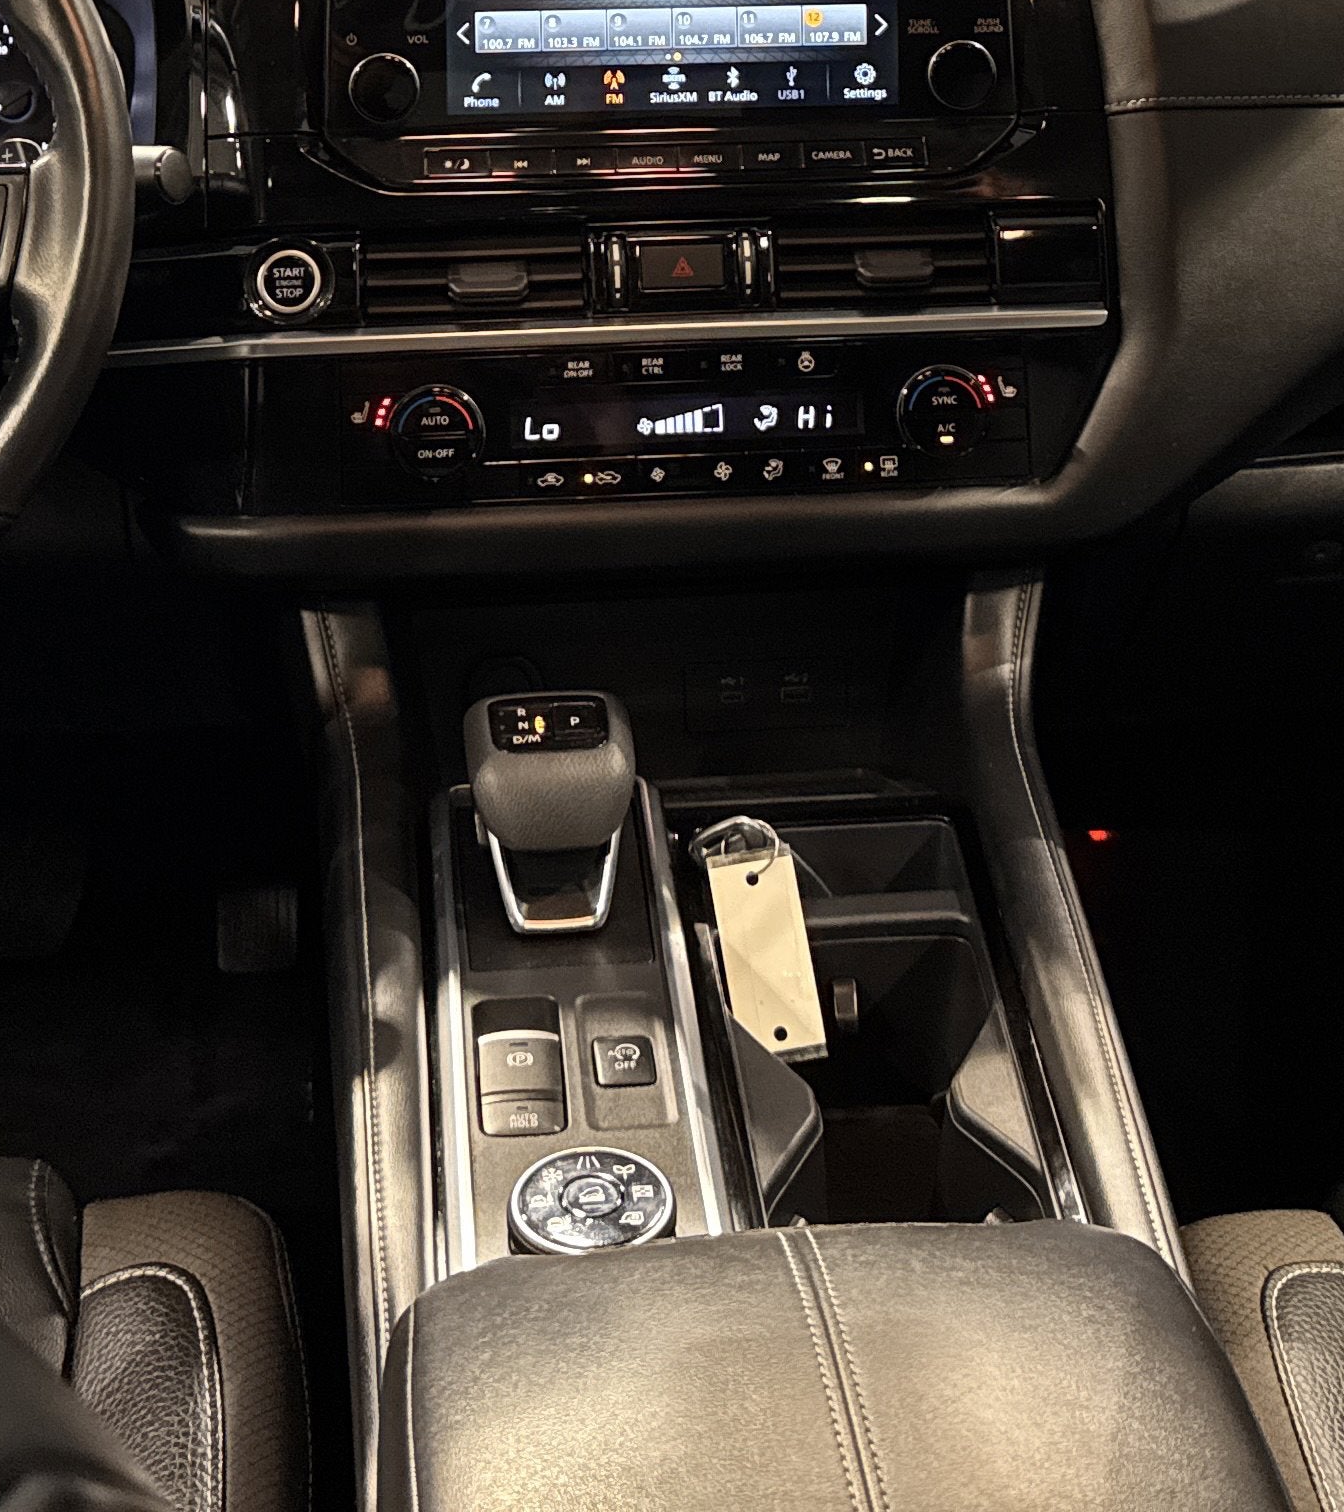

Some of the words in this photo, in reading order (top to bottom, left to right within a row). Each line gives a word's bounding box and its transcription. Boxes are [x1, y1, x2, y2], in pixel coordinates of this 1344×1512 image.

[613, 15, 623, 27] 9
[677, 14, 691, 26] 10
[742, 13, 755, 24] 11
[807, 12, 821, 23] 12
[407, 35, 429, 44] VOL
[547, 37, 578, 49] 103.3
[583, 36, 600, 48] FM
[613, 35, 643, 47] 104.1
[648, 35, 666, 46] FM
[679, 34, 709, 45] 104.7
[713, 34, 731, 45] FM
[744, 33, 774, 44] 106.7
[778, 33, 796, 44] FM
[809, 31, 839, 43] 107.9
[843, 31, 861, 42] FM
[482, 38, 513, 50] 100.7
[517, 37, 535, 49] FM
[544, 94, 565, 106] AM
[605, 93, 624, 105] FM
[650, 90, 698, 103] SiriusXM
[708, 90, 722, 102] BT
[724, 90, 758, 102] Audio
[777, 89, 805, 100] USB1
[843, 88, 888, 101] Settings
[463, 96, 500, 108] Phone
[693, 154, 723, 163] MENU
[758, 152, 780, 161] MAP
[811, 150, 852, 160] CAMERA
[887, 148, 913, 158] BACK
[631, 156, 664, 165] AUDIO
[273, 267, 305, 278] START
[275, 288, 303, 298] STOP
[642, 358, 664, 366] REAR
[721, 354, 743, 362] REAR
[568, 361, 590, 369] REAR
[642, 366, 664, 375] CTRL
[721, 362, 743, 371] LOCK
[931, 395, 958, 405] SYNC
[421, 415, 449, 426] AUTO
[798, 405, 833, 430] Hi
[524, 416, 560, 441] Lo
[937, 423, 956, 433] A/C
[822, 472, 845, 480] FRONT
[517, 708, 526, 717] R
[518, 721, 529, 731] N
[570, 716, 580, 726] P
[512, 734, 541, 745] D/M
[614, 1060, 637, 1070] OFF
[509, 1113, 538, 1121] AUTO
[509, 1120, 539, 1128] HOLD
